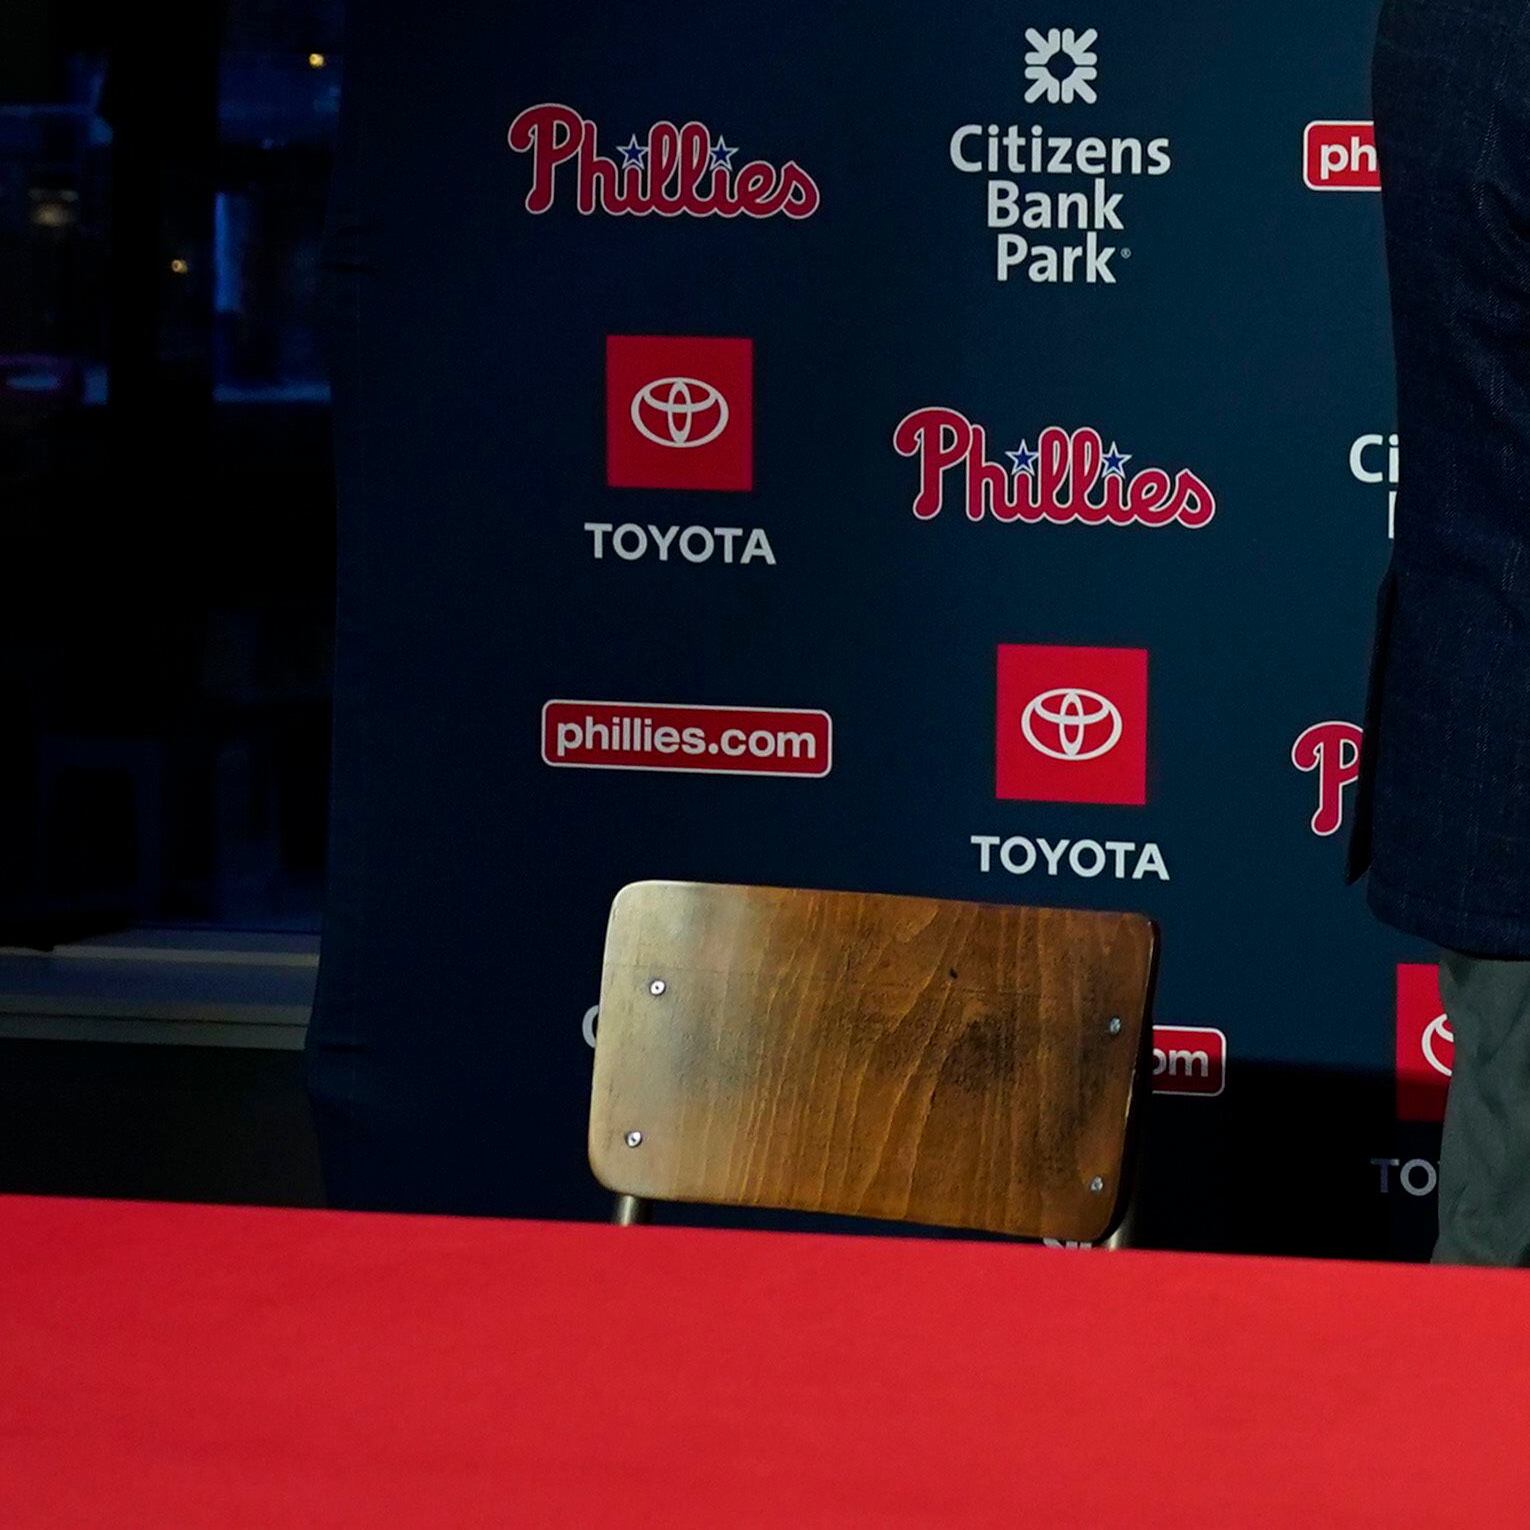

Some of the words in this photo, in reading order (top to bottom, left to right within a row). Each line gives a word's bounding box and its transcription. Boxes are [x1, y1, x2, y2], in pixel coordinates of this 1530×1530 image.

[508, 103, 820, 219] Phillies
[950, 125, 1170, 175] Citizens
[988, 178, 1124, 229] Bank
[998, 231, 1116, 283] Park
[893, 407, 1216, 529] Phillies
[584, 523, 776, 564] TOYOTA
[557, 716, 816, 758] phillies.com
[971, 836, 1169, 880] TOYOTA
